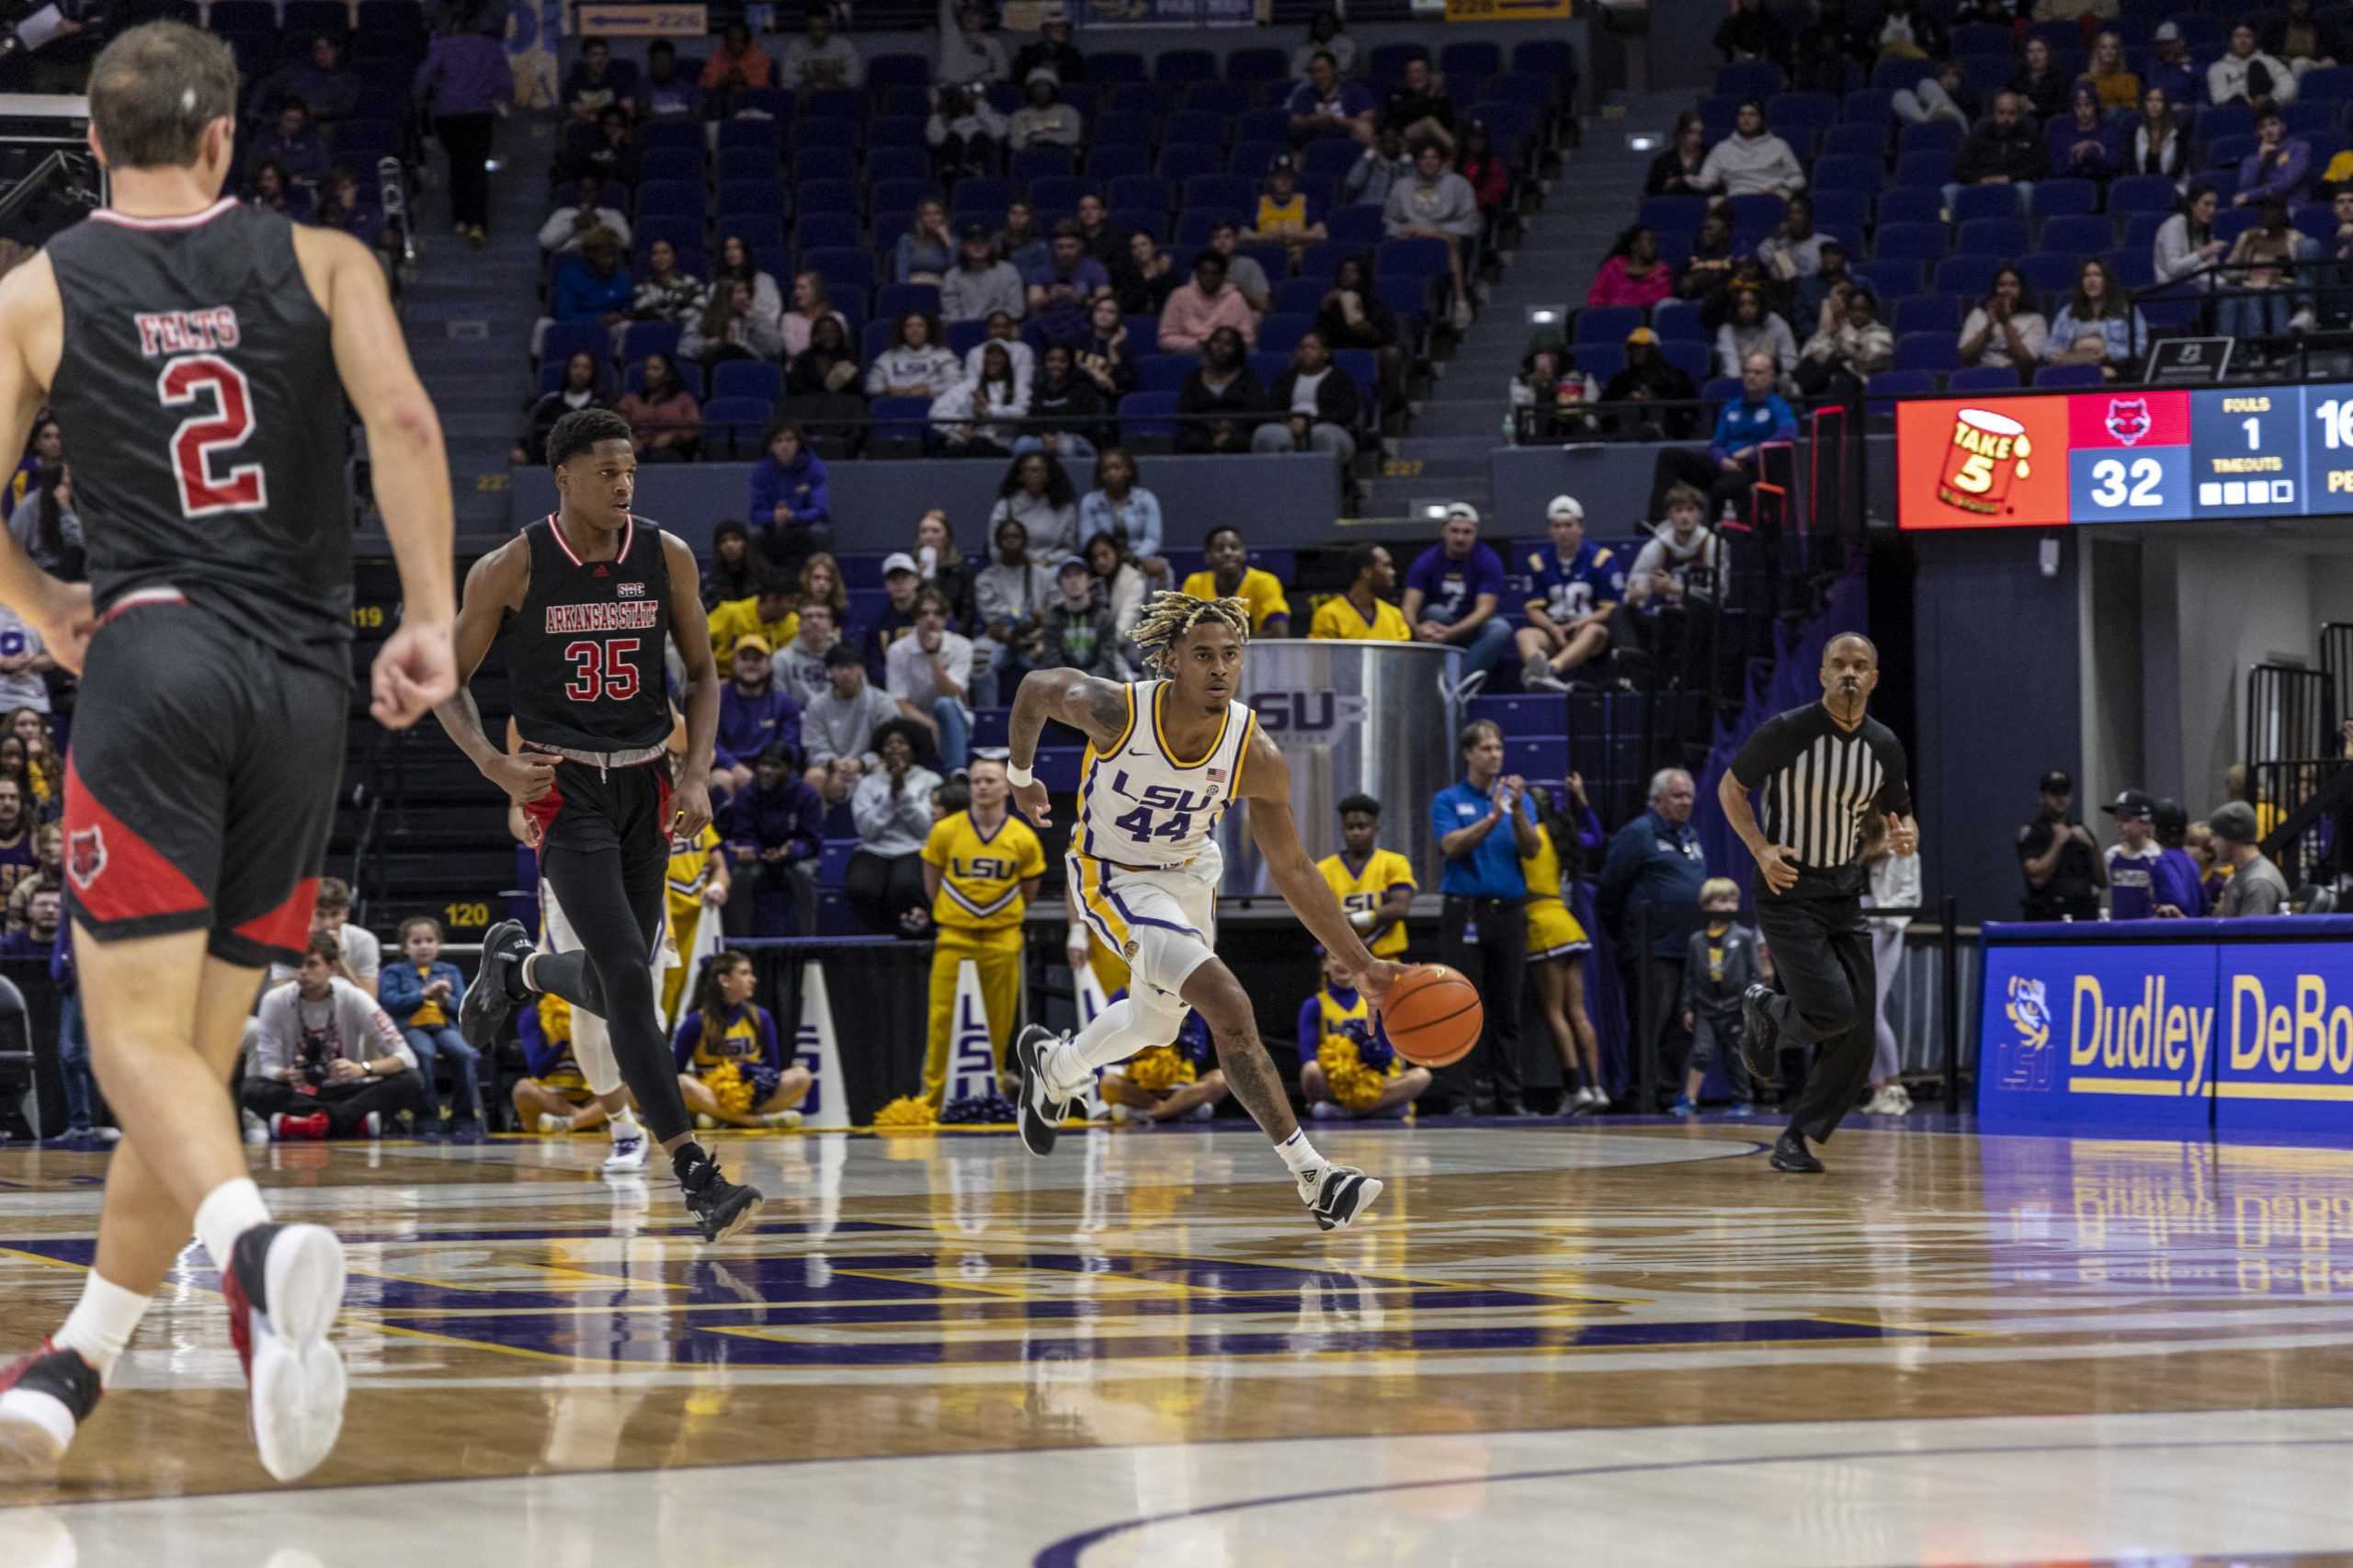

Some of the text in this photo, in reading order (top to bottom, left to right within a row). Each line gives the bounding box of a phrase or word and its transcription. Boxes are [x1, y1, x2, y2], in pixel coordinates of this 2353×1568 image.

[133, 306, 241, 356] FELTS
[2222, 397, 2270, 414] FOULS
[157, 353, 268, 517] 2
[1954, 422, 2013, 460] TAKE
[2242, 416, 2261, 450] 1
[1954, 454, 1995, 493] 5
[2091, 458, 2164, 506] 32
[2212, 456, 2283, 473] TIMEOUTS
[618, 583, 644, 597] SBC
[546, 600, 658, 633] ARKANSAS STATE
[565, 638, 641, 701] 35
[1249, 692, 1336, 730] SU
[1112, 769, 1211, 812] LSU
[1115, 806, 1191, 843] 44
[952, 858, 1016, 879] LSU
[445, 902, 488, 926] 120
[2068, 975, 2214, 1096] Dudley
